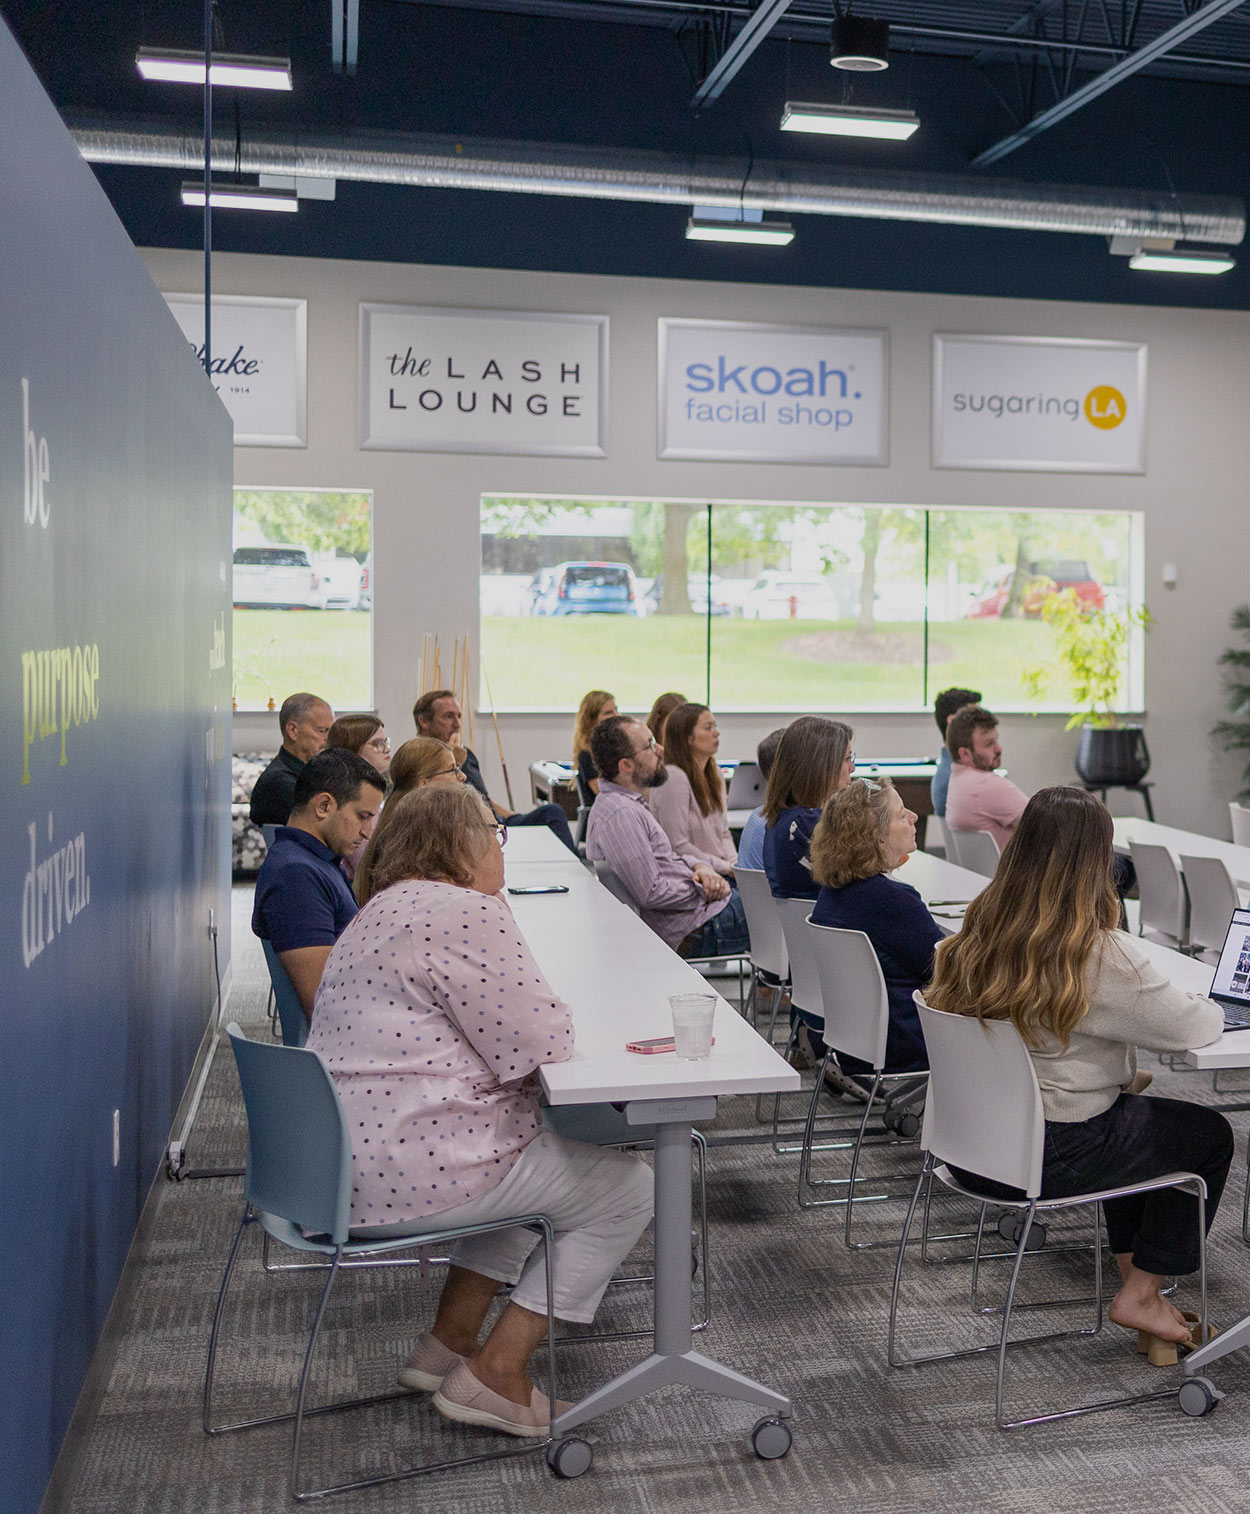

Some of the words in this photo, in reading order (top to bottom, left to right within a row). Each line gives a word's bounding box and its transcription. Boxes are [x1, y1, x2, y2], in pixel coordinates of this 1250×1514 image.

[385, 346, 432, 377] the
[447, 357, 580, 384] LASH
[389, 388, 581, 417] LOUNGE
[685, 398, 766, 424] facial
[777, 402, 853, 432] shop
[952, 393, 1080, 421] sugaring
[1090, 398, 1122, 419] LA
[21, 377, 50, 529] be
[22, 643, 100, 786] purpose
[21, 809, 91, 968] driven.
